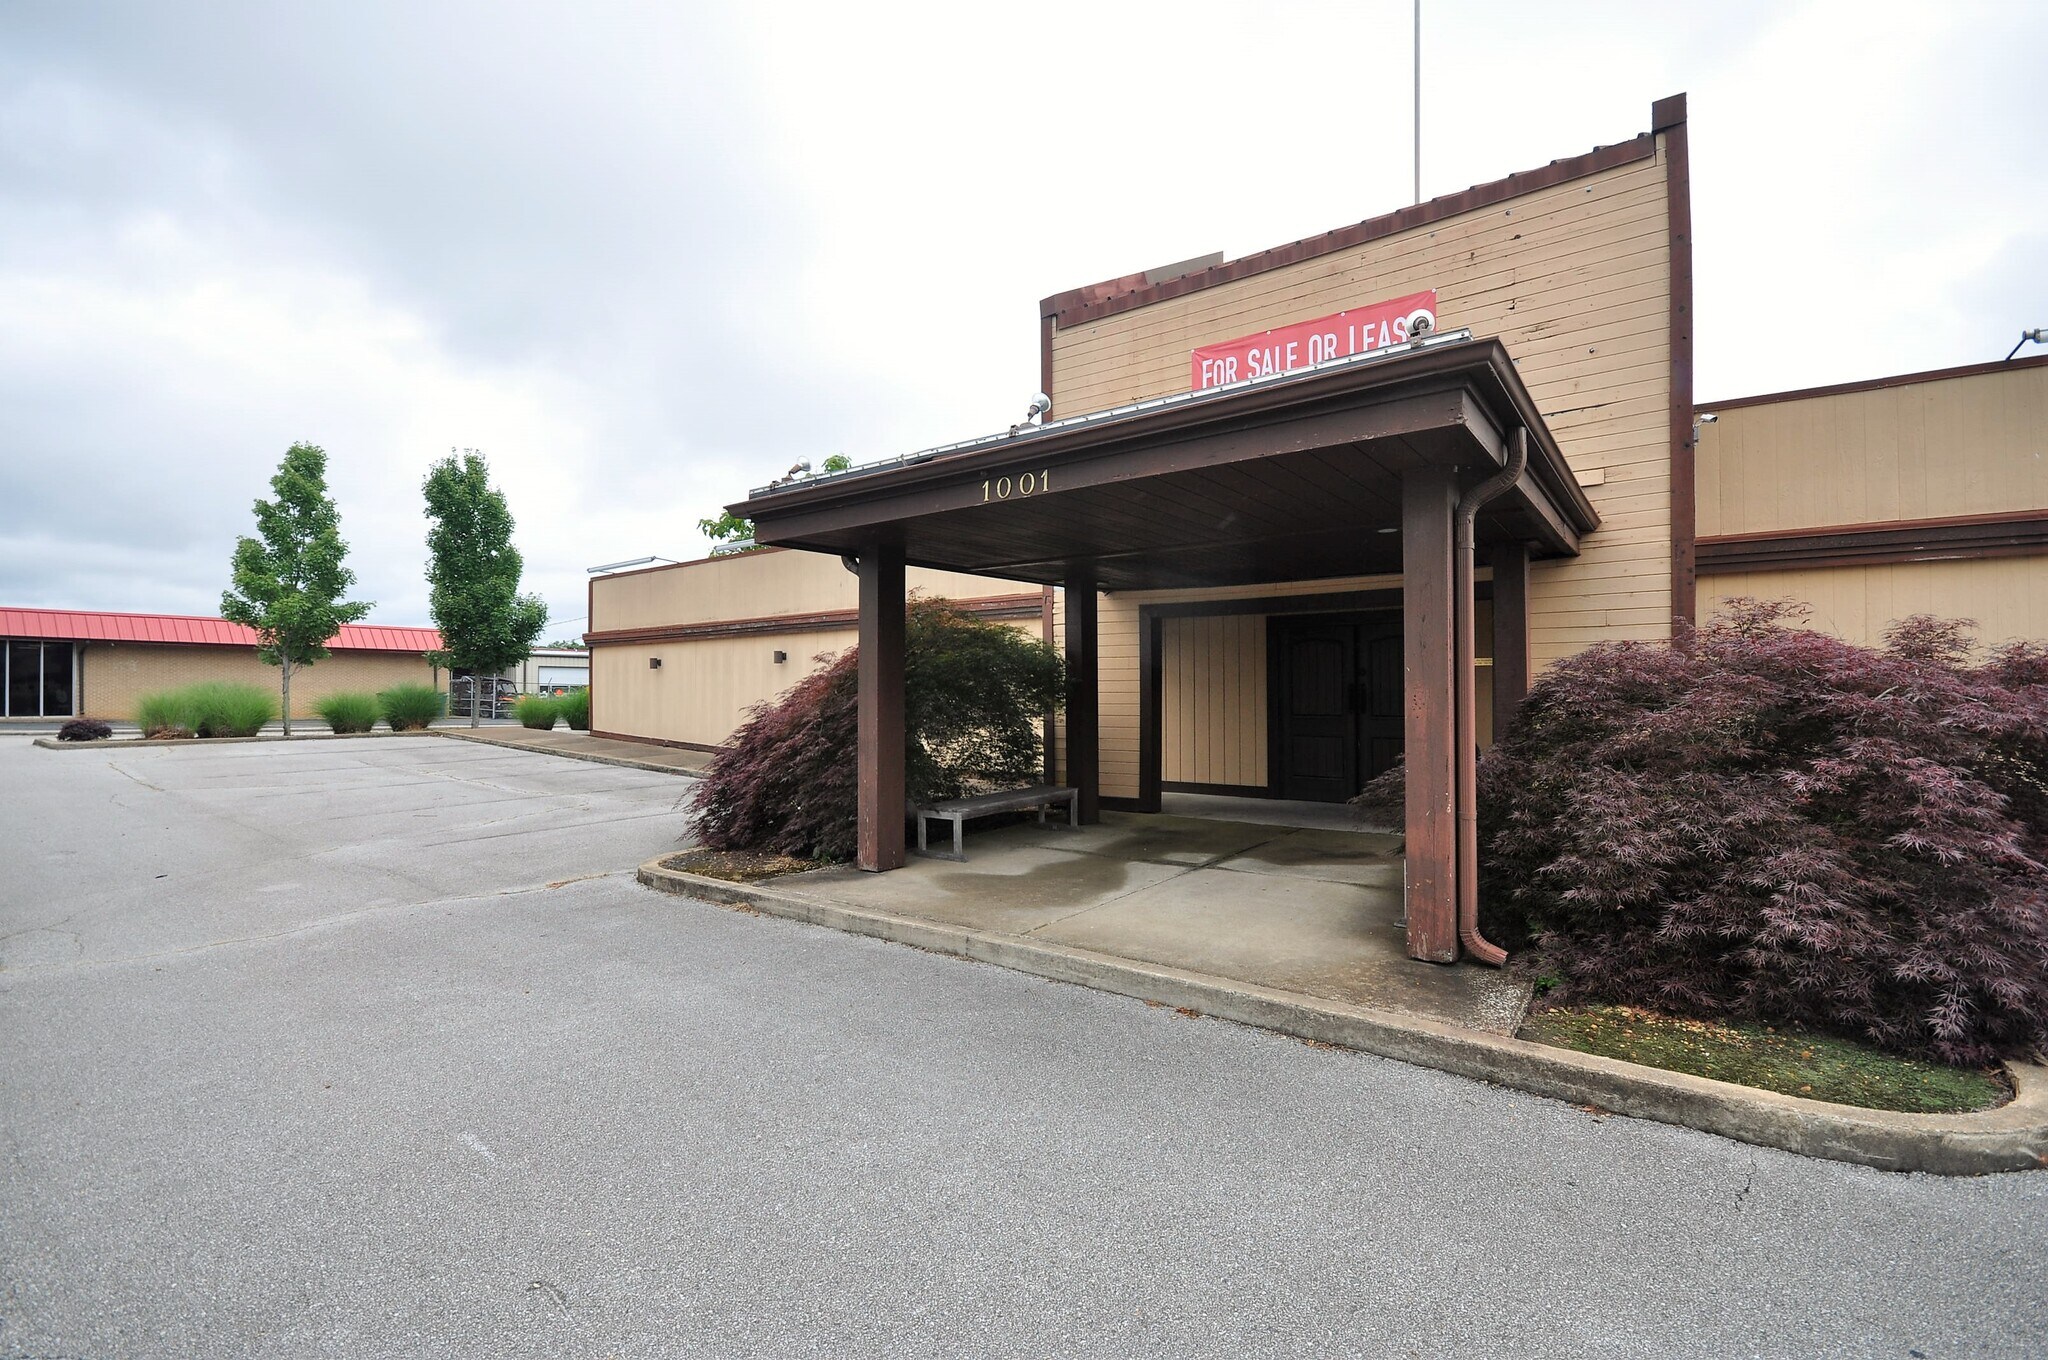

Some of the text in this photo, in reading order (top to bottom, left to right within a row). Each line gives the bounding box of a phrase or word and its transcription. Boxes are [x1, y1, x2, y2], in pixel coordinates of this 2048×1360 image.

[1202, 316, 1409, 389] FOR SALE OR LEAS
[982, 469, 1049, 502] 1001
